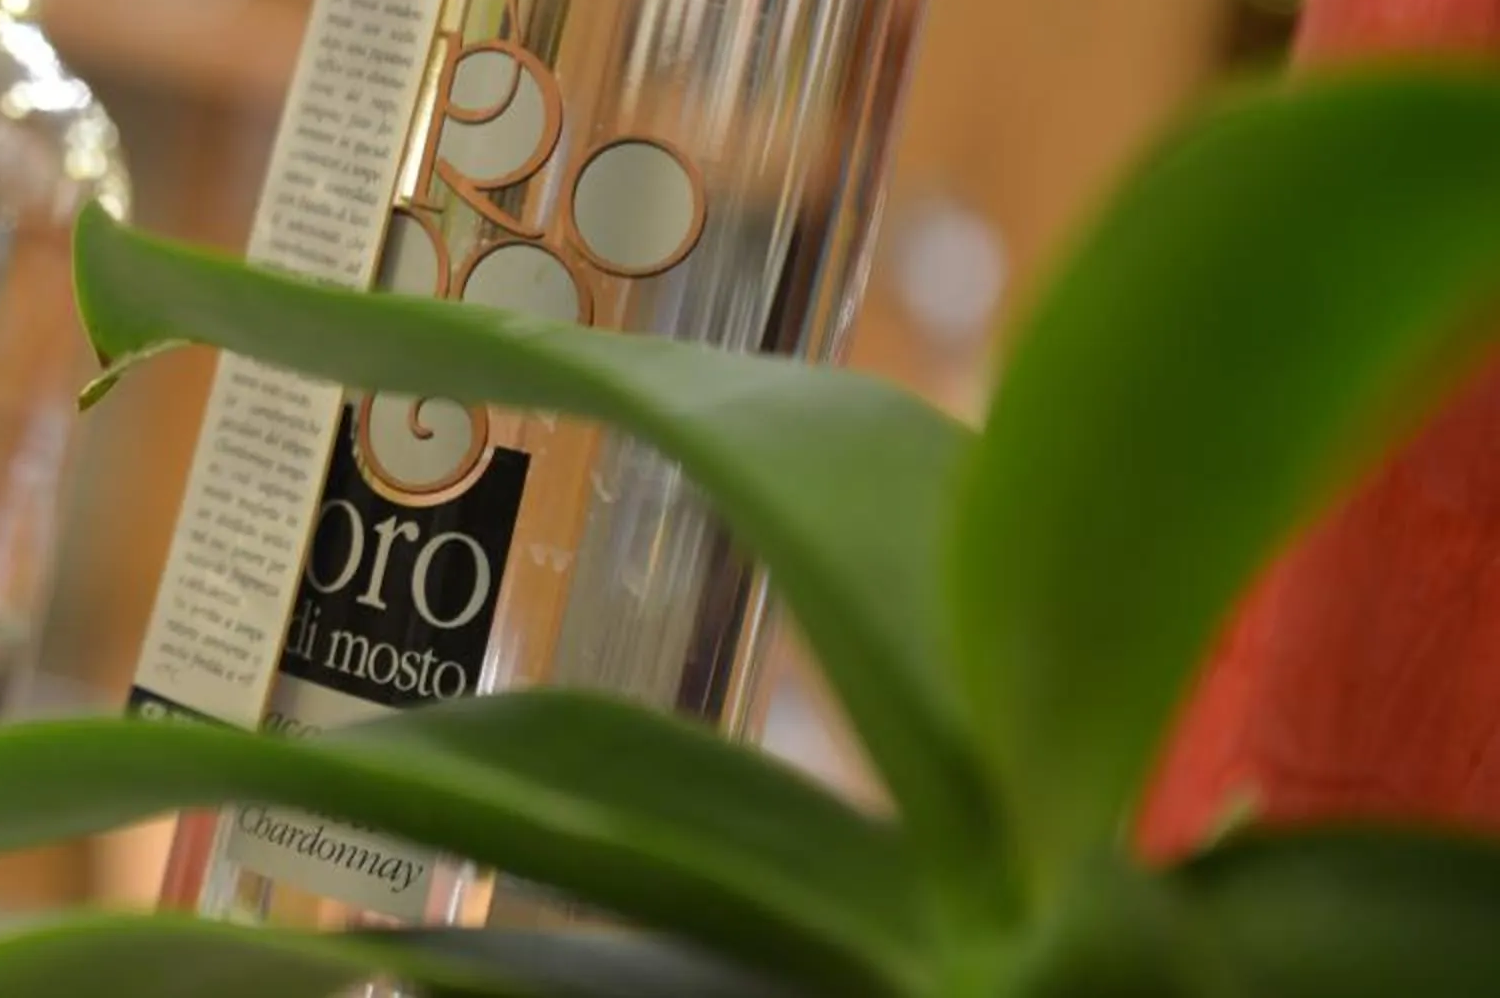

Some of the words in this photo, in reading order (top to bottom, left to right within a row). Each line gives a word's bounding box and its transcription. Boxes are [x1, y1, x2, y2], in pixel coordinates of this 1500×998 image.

[306, 498, 491, 629] oro
[323, 629, 467, 701] mosto
[238, 803, 424, 894] Chardonnay
